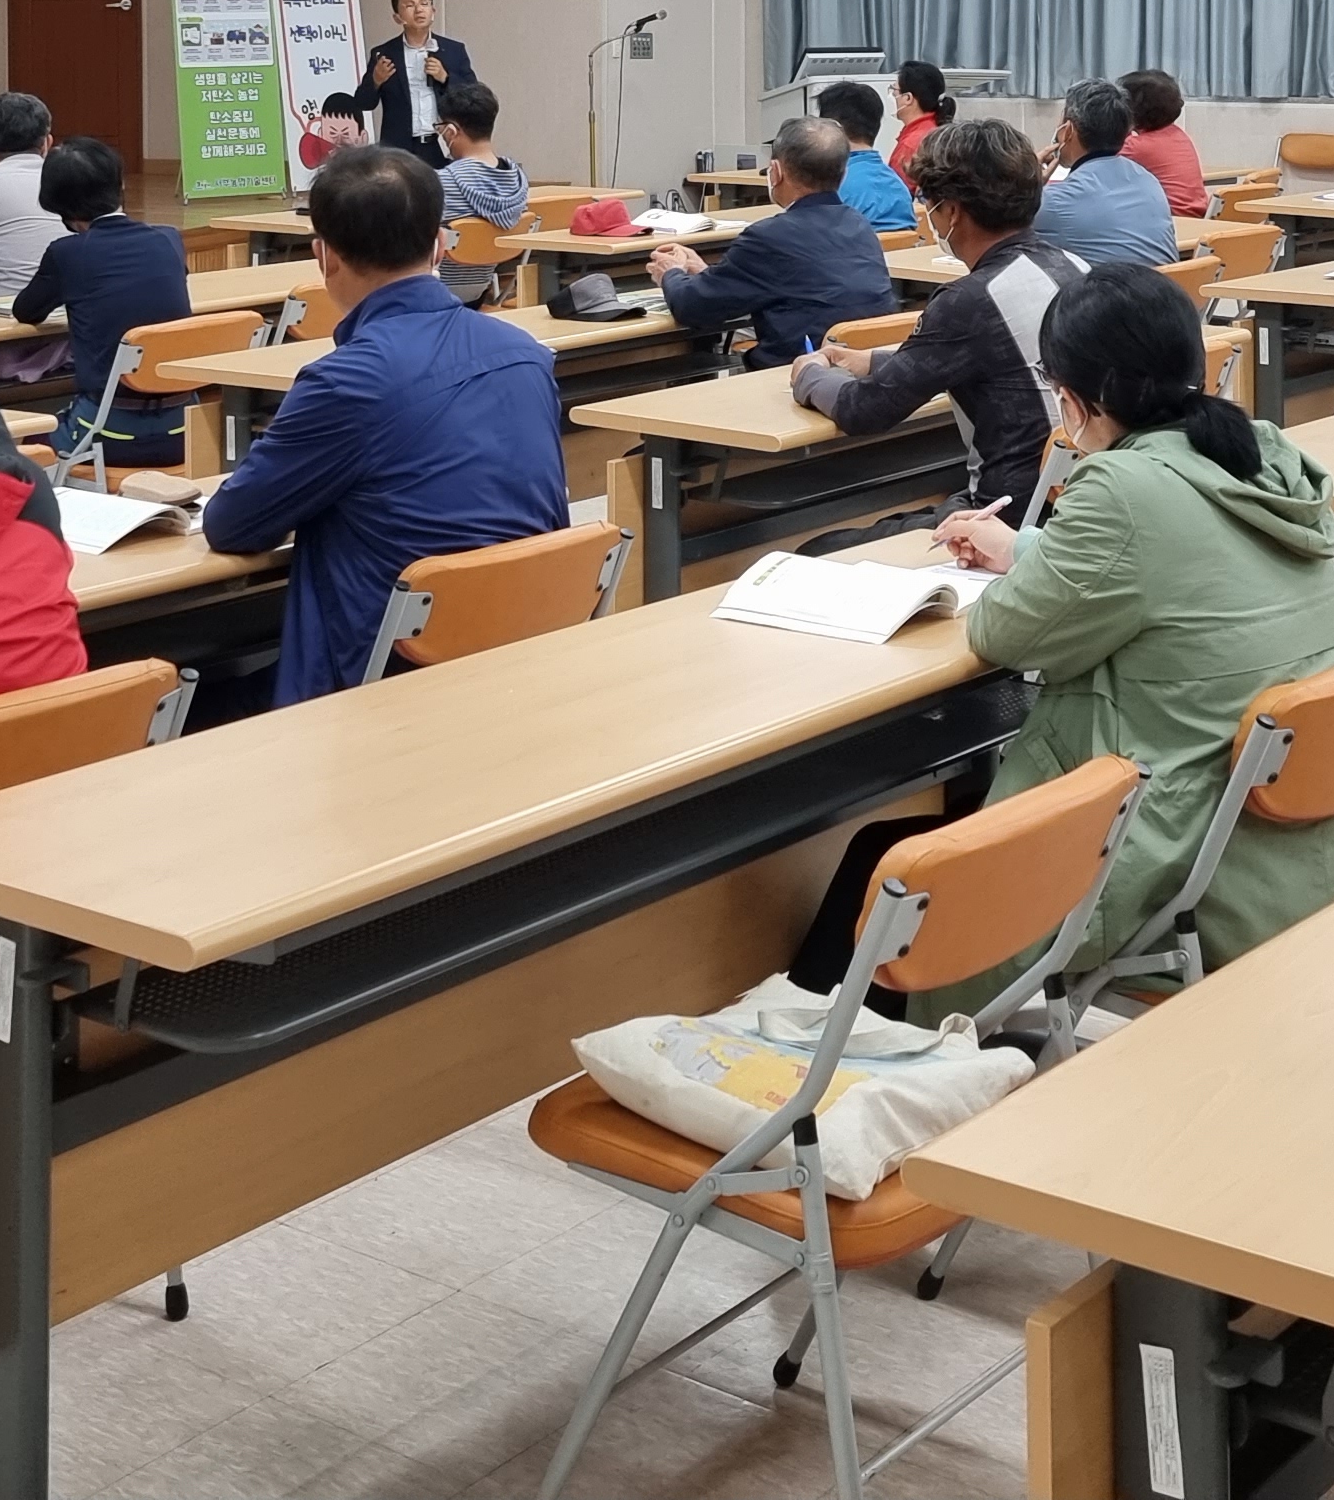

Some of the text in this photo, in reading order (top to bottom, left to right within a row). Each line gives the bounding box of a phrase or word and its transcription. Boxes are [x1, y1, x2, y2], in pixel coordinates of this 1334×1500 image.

[289, 23, 348, 43] 선택이 아닌
[194, 71, 264, 86] 생명을 살리는
[201, 88, 259, 102] 저탄소 농업
[209, 110, 253, 124] 탄소중립
[205, 126, 261, 141] 실천운동에
[201, 143, 268, 159] 함께해주세요
